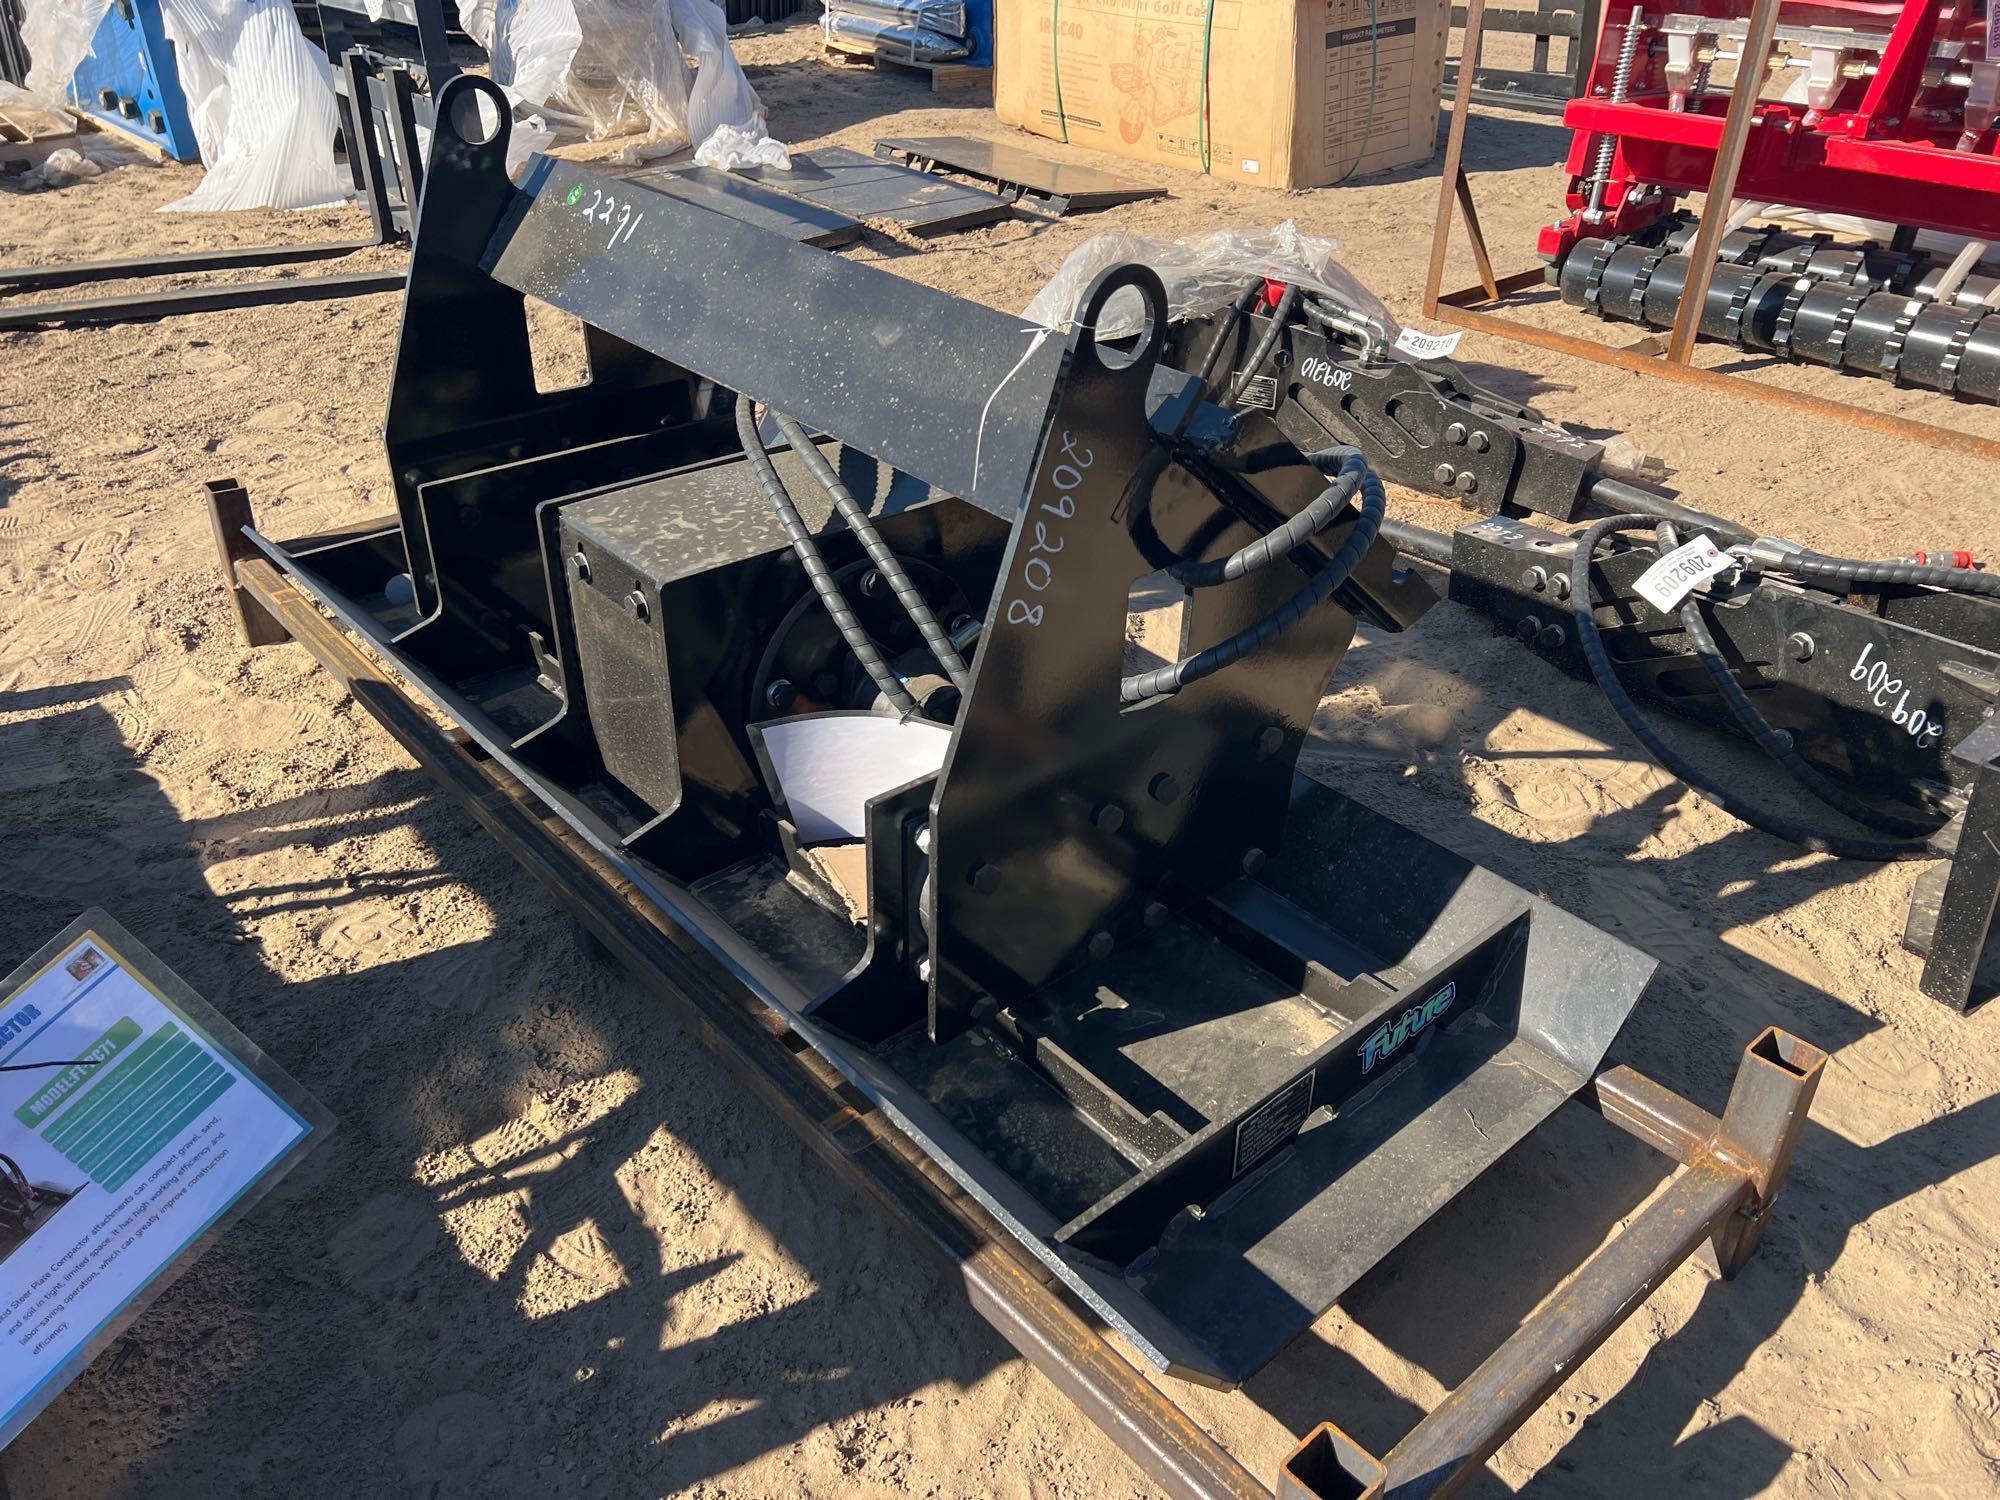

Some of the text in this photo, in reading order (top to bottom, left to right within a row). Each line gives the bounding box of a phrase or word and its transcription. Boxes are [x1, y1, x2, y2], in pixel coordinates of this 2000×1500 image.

[1040, 16, 1084, 40] IRC40
[1153, 1, 1181, 15] Golf
[1342, 30, 1365, 40] PRODUCT
[582, 189, 643, 249] 2291
[1411, 335, 1454, 351] 209210
[1301, 357, 1352, 391] 209210
[1008, 430, 1094, 626] 209208
[1654, 555, 1712, 597] 209209
[1850, 642, 1944, 749] 209209
[7, 1319, 23, 1335] and
[22, 1306, 37, 1321] soil
[35, 1298, 46, 1308] in
[45, 1279, 66, 1301] tight,
[63, 1256, 90, 1281] limited
[119, 1215, 133, 1230] has
[132, 1199, 151, 1218] high
[149, 1174, 178, 1202] working
[177, 1143, 211, 1177] efficiency
[210, 1131, 225, 1146] and
[11, 1288, 32, 1309] Steer
[31, 1270, 51, 1290] Plate
[50, 1234, 91, 1273] Compactor
[90, 1193, 134, 1236] attachments
[133, 1181, 148, 1196] can
[147, 1153, 179, 1184] compact
[63, 1269, 100, 1304] operation,
[97, 1247, 121, 1271] which
[120, 1235, 135, 1250] can
[134, 1212, 161, 1238] greatly
[159, 1186, 188, 1214] improve
[187, 1147, 229, 1188] construction
